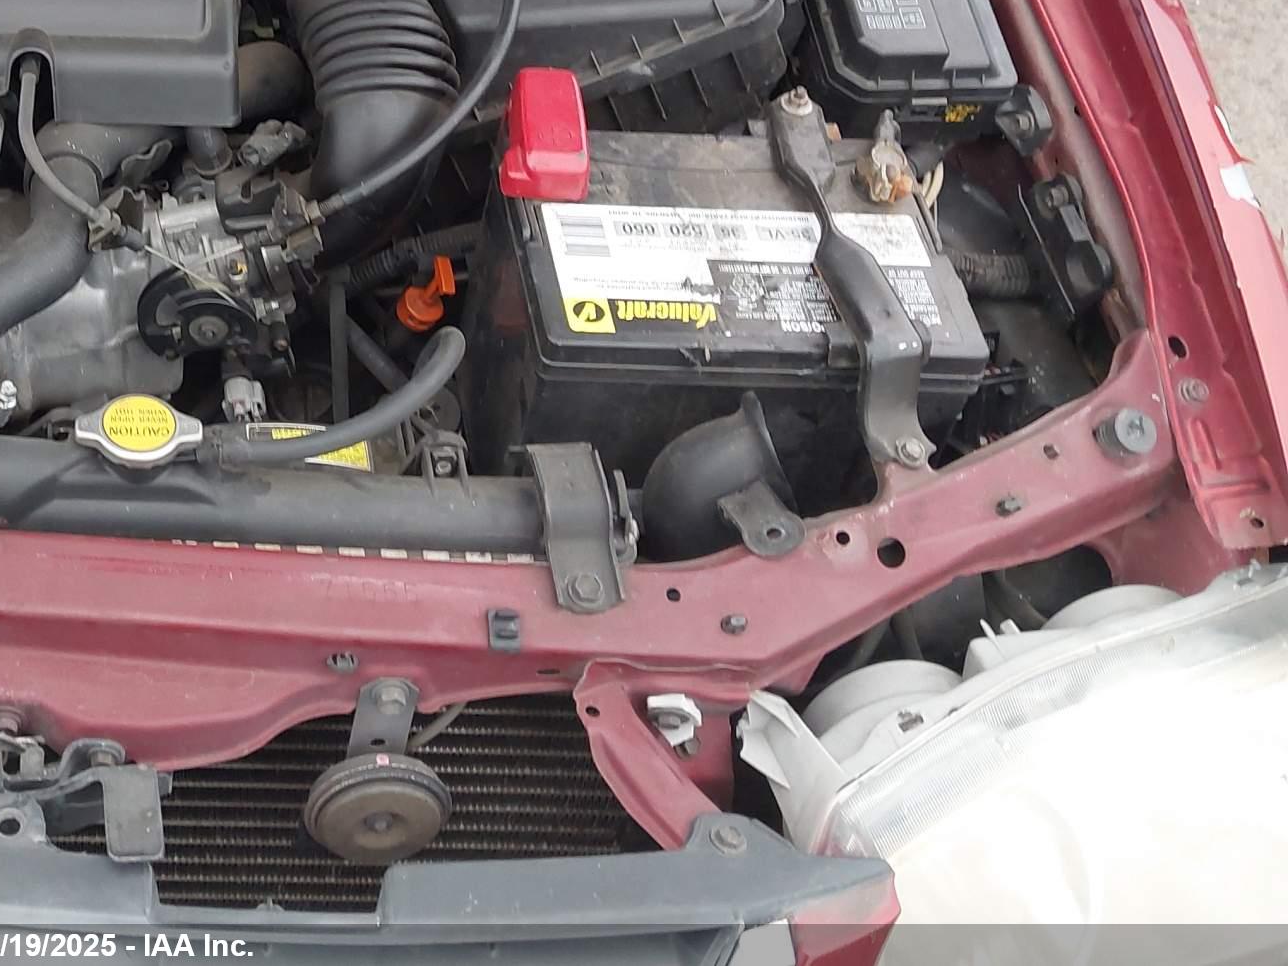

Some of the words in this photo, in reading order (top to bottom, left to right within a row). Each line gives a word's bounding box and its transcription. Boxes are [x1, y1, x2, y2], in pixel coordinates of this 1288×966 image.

[617, 300, 717, 329] Valucraft
[110, 415, 135, 424] OPEN
[139, 415, 169, 424] NEVER
[109, 425, 170, 436] CAUTION
